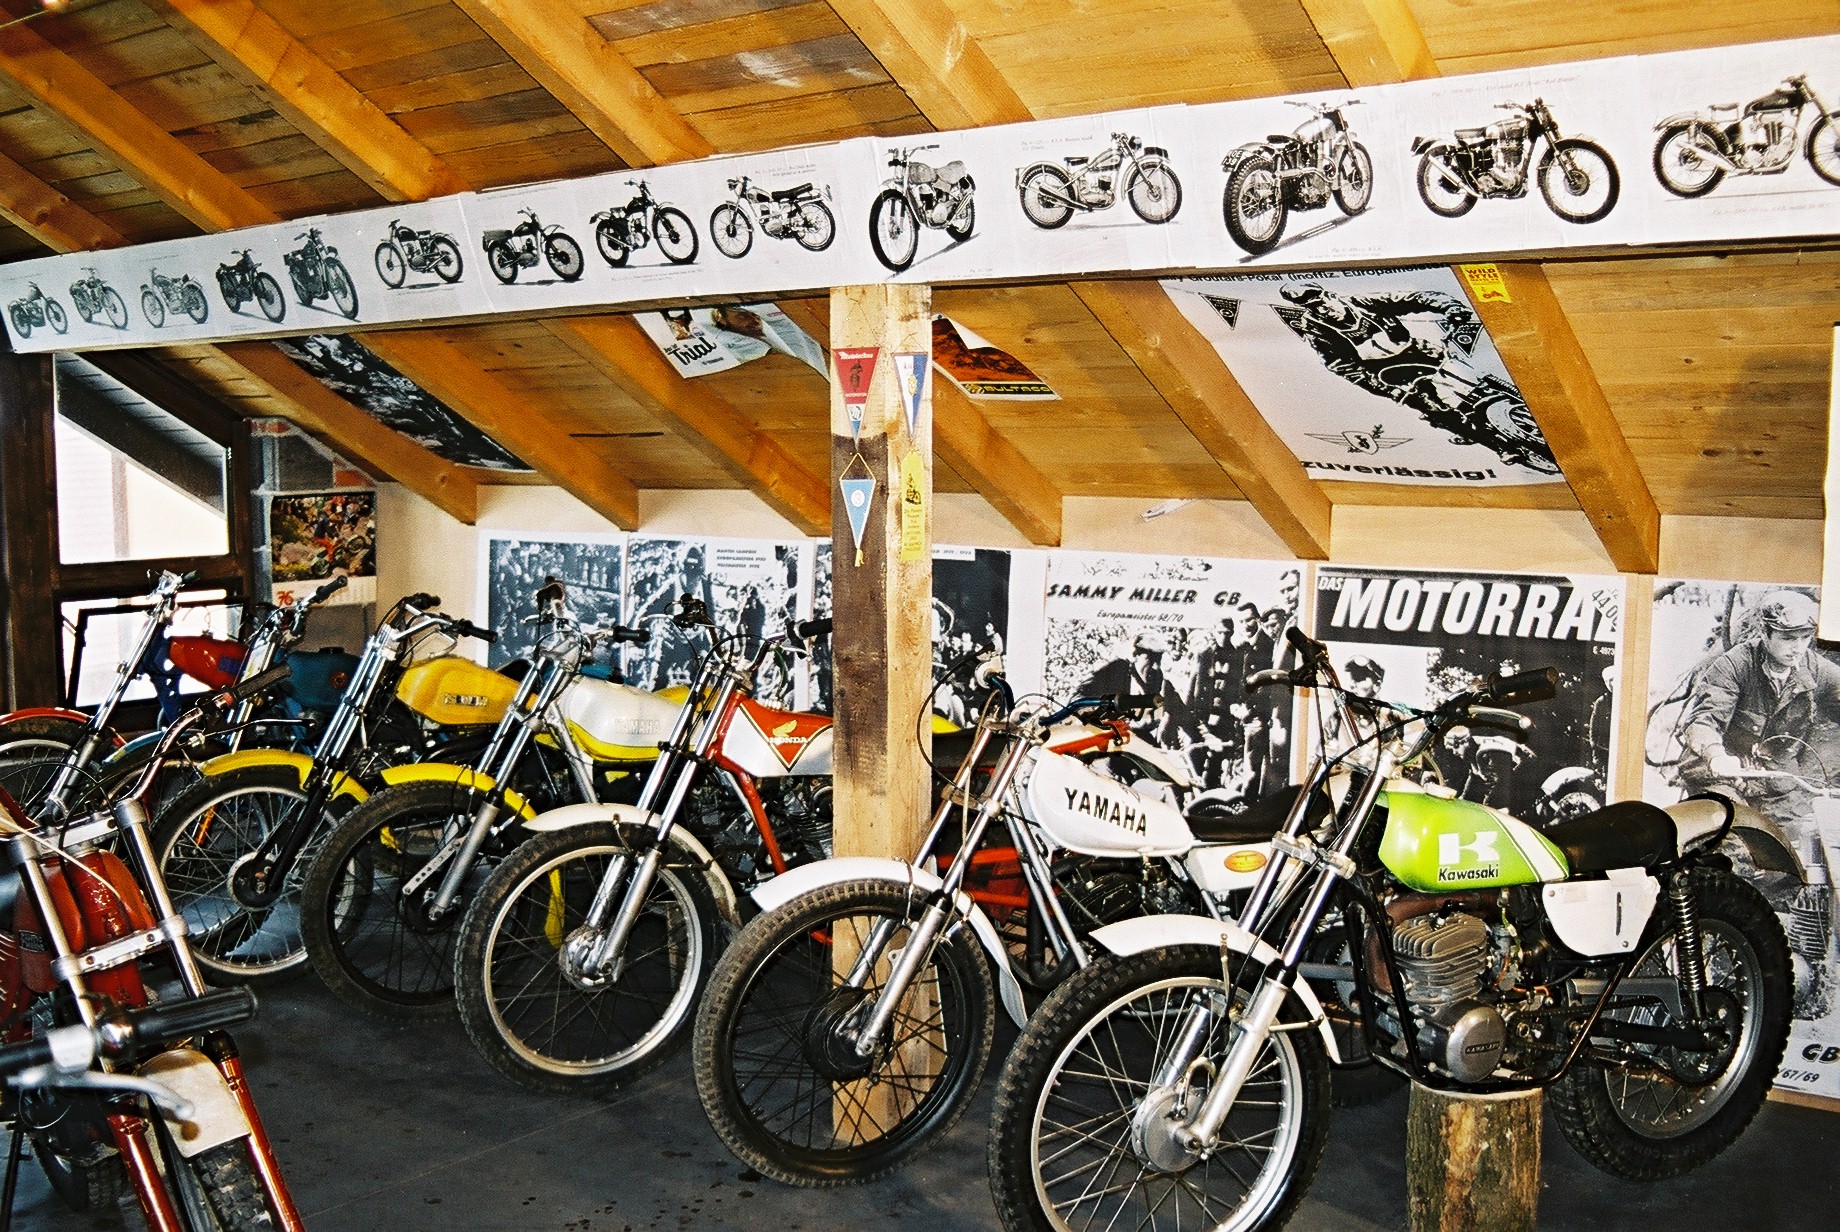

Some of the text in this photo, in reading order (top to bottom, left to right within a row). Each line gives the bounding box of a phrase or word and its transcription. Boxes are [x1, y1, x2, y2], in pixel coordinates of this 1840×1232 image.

[667, 336, 717, 366] Trial
[1301, 460, 1497, 481] zuverlässig!
[1318, 576, 1343, 591] DAS
[1047, 583, 1242, 606] SAMMY MILLER GB
[768, 736, 808, 746] HONDA
[1064, 786, 1147, 837] YAMAHA
[1438, 864, 1499, 881] Kawasaki
[1801, 1043, 1840, 1063] GB
